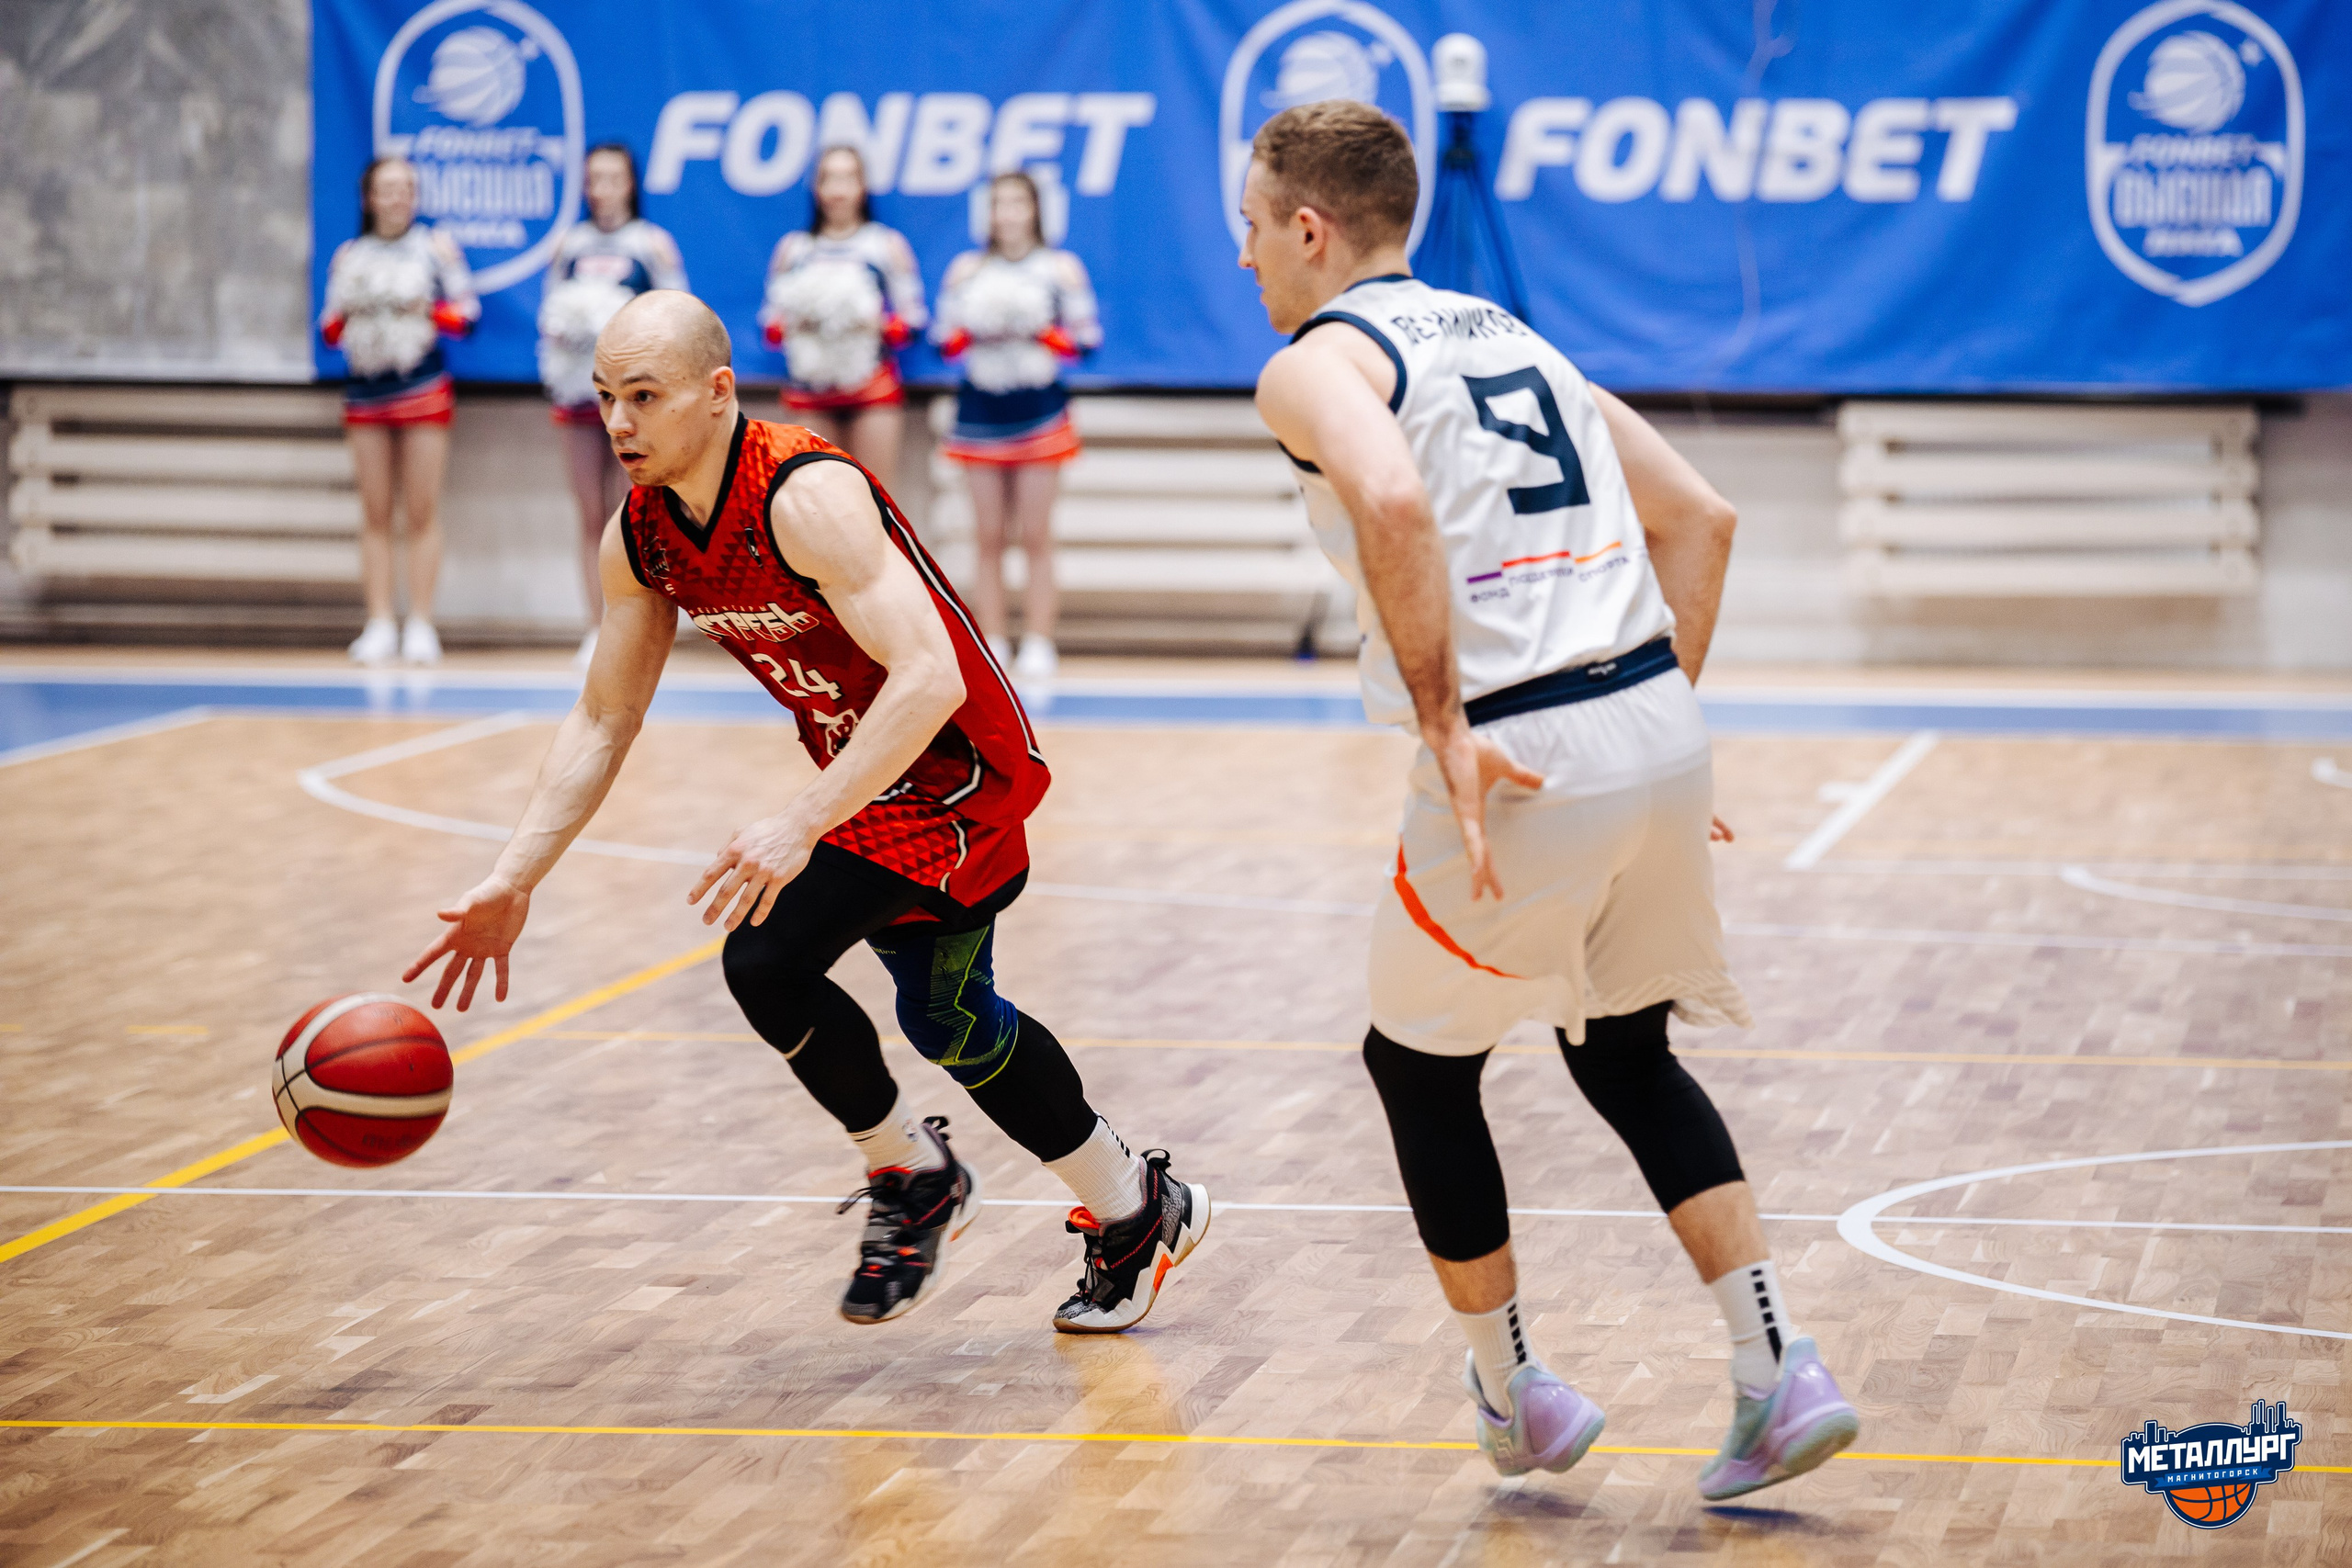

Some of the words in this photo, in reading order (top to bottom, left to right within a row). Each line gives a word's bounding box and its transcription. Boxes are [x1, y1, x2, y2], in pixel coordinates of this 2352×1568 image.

[643, 90, 1156, 196] FONBET
[1494, 96, 2019, 203] FONBET
[1461, 365, 1591, 515] 9
[750, 652, 843, 701] 24
